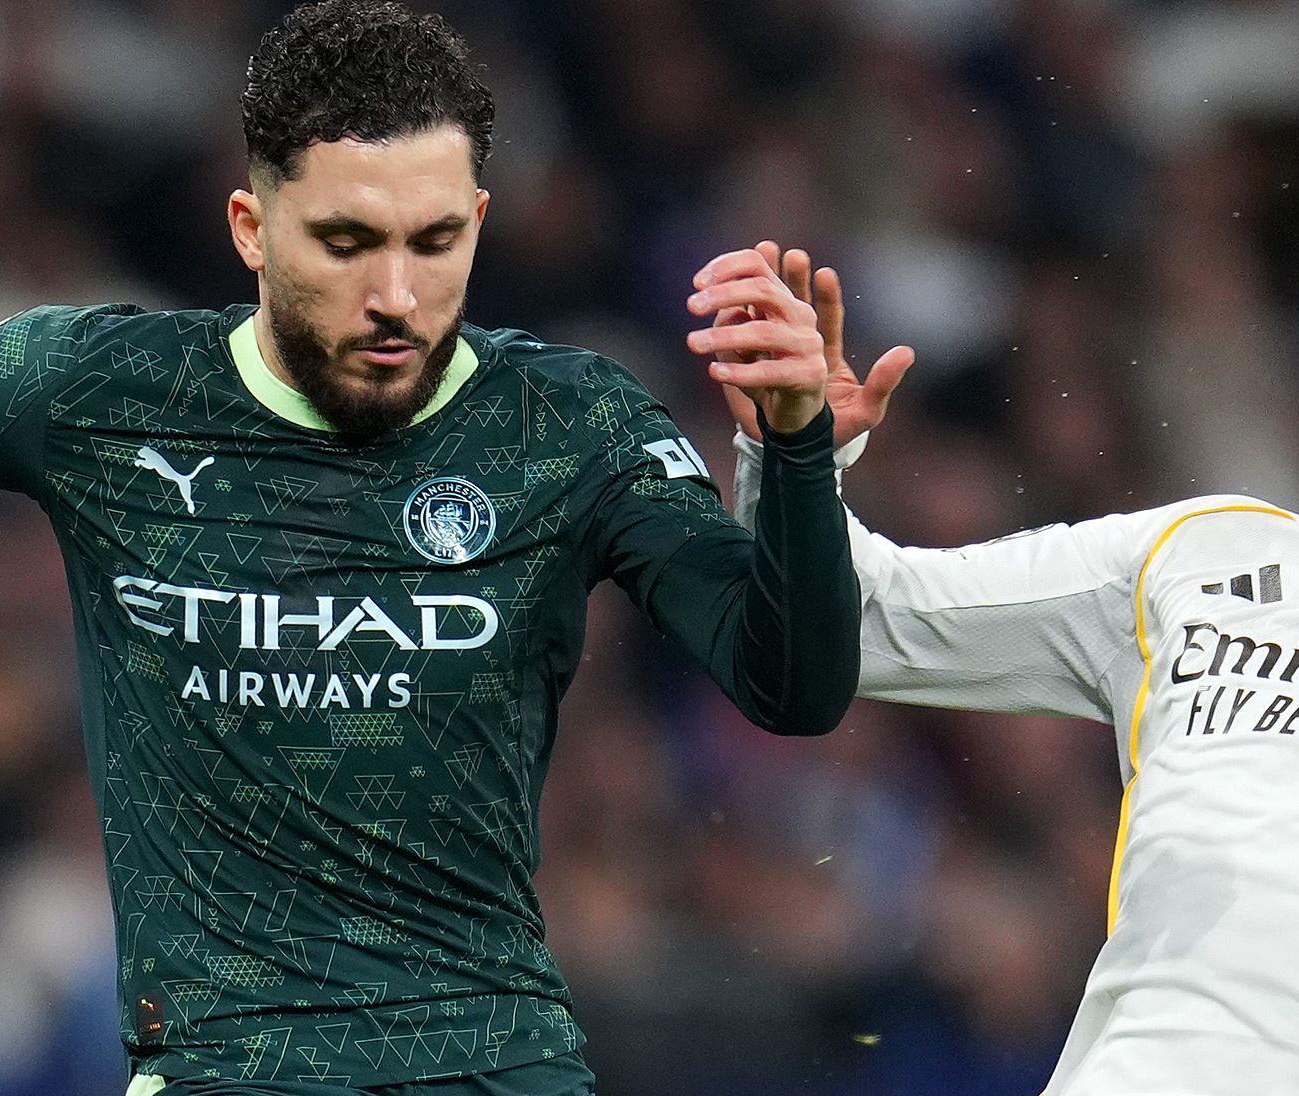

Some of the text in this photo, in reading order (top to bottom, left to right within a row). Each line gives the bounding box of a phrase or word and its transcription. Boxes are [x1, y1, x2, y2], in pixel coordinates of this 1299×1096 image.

[414, 482, 487, 513] MANCHESTER
[112, 574, 499, 652] ETIHAD
[181, 665, 412, 709] AIRWAYS
[1185, 685, 1246, 737] FLY
